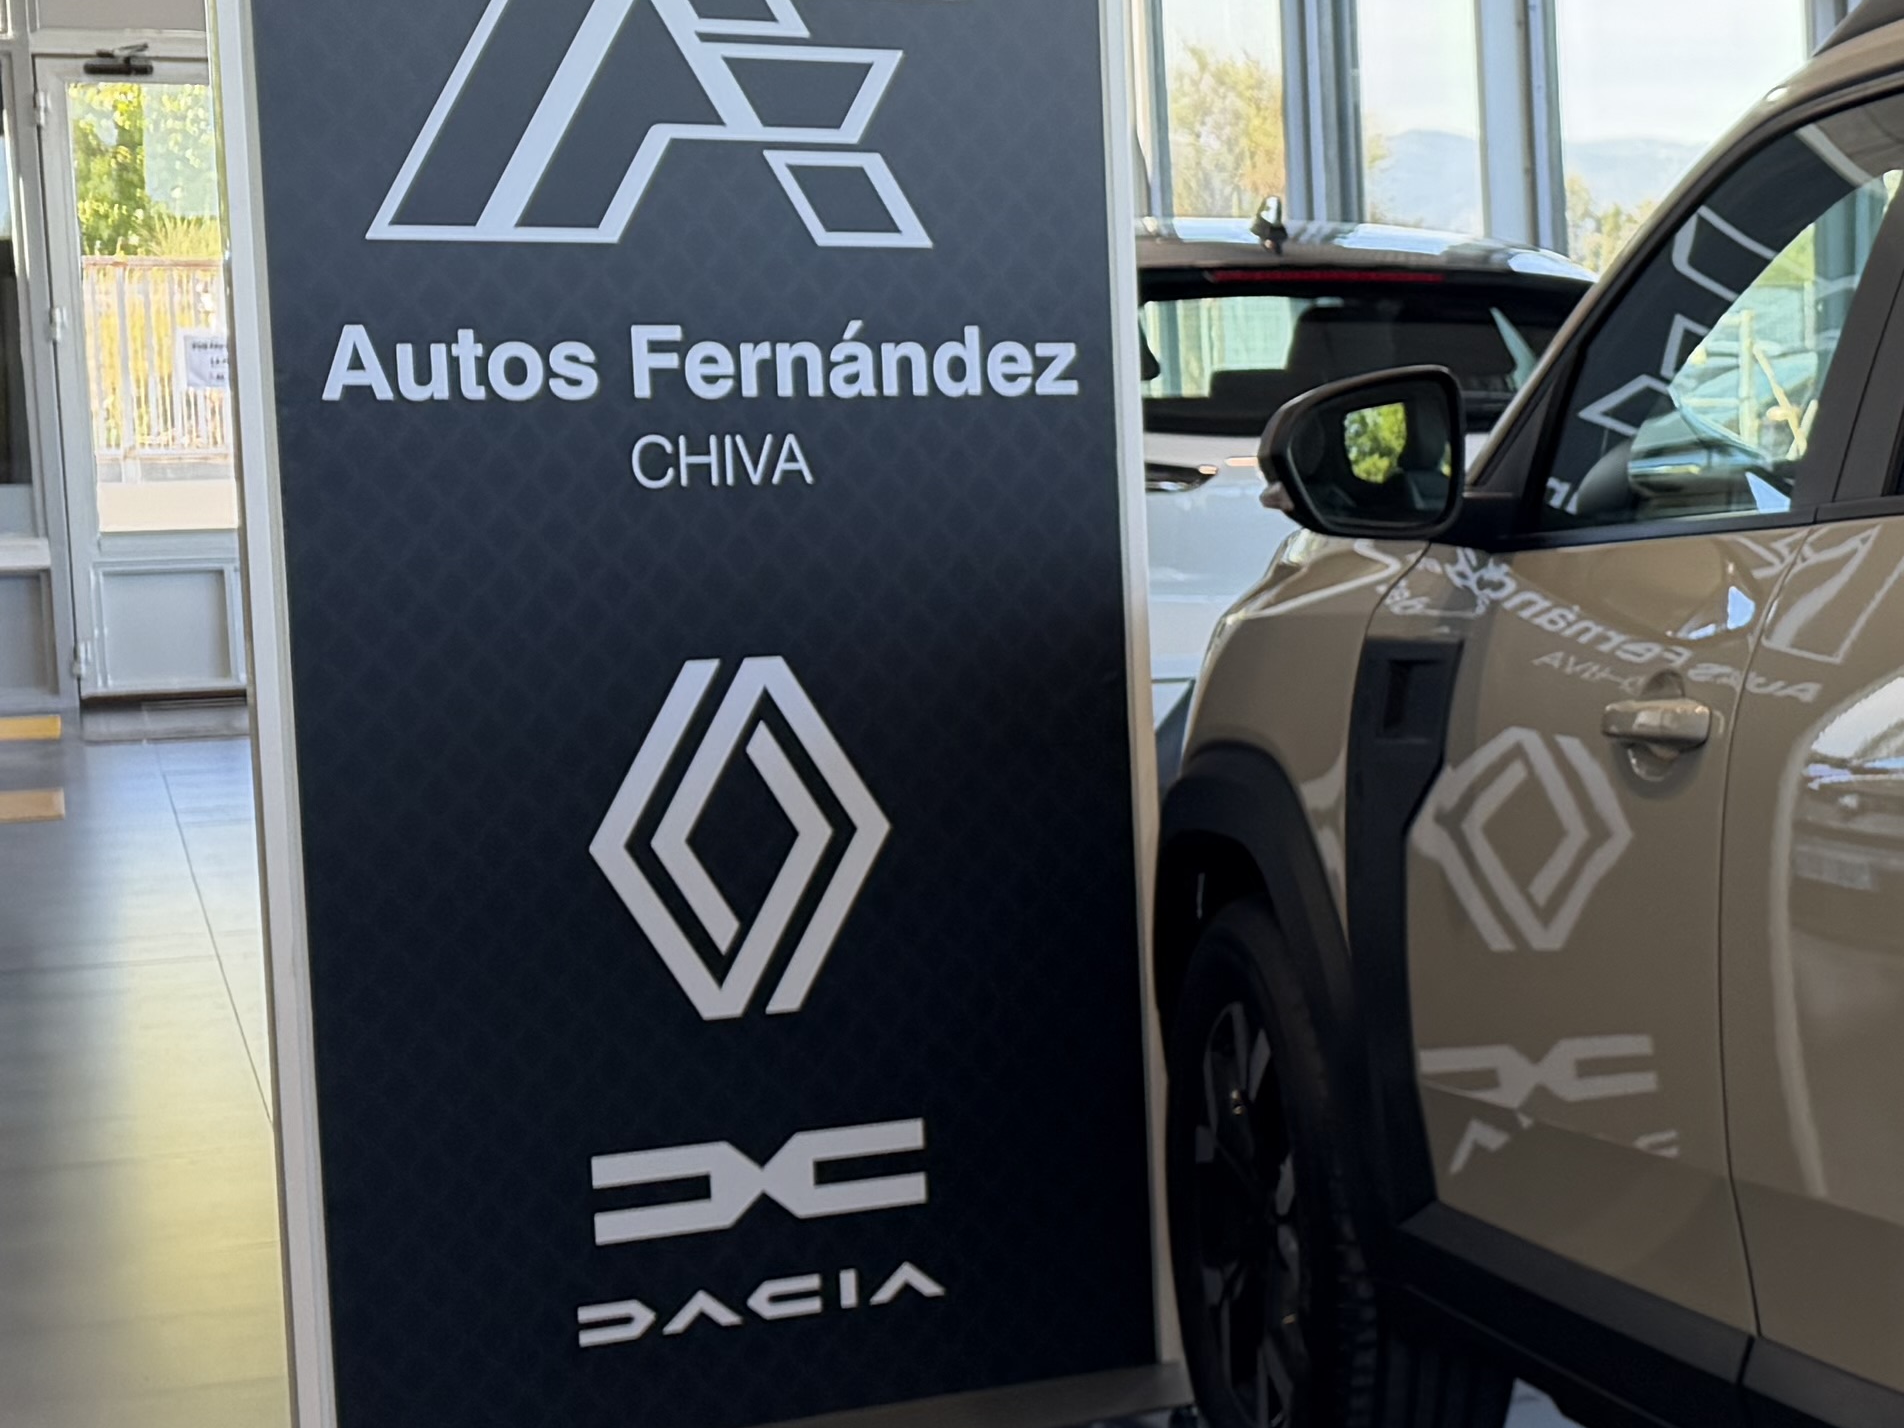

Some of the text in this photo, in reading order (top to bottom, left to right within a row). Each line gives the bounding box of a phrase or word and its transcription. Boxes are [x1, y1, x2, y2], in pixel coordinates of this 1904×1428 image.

[321, 323, 599, 403] Autos
[631, 320, 1079, 399] Fernández
[631, 434, 814, 489] CHIVA
[577, 1261, 946, 1348] DACIA
